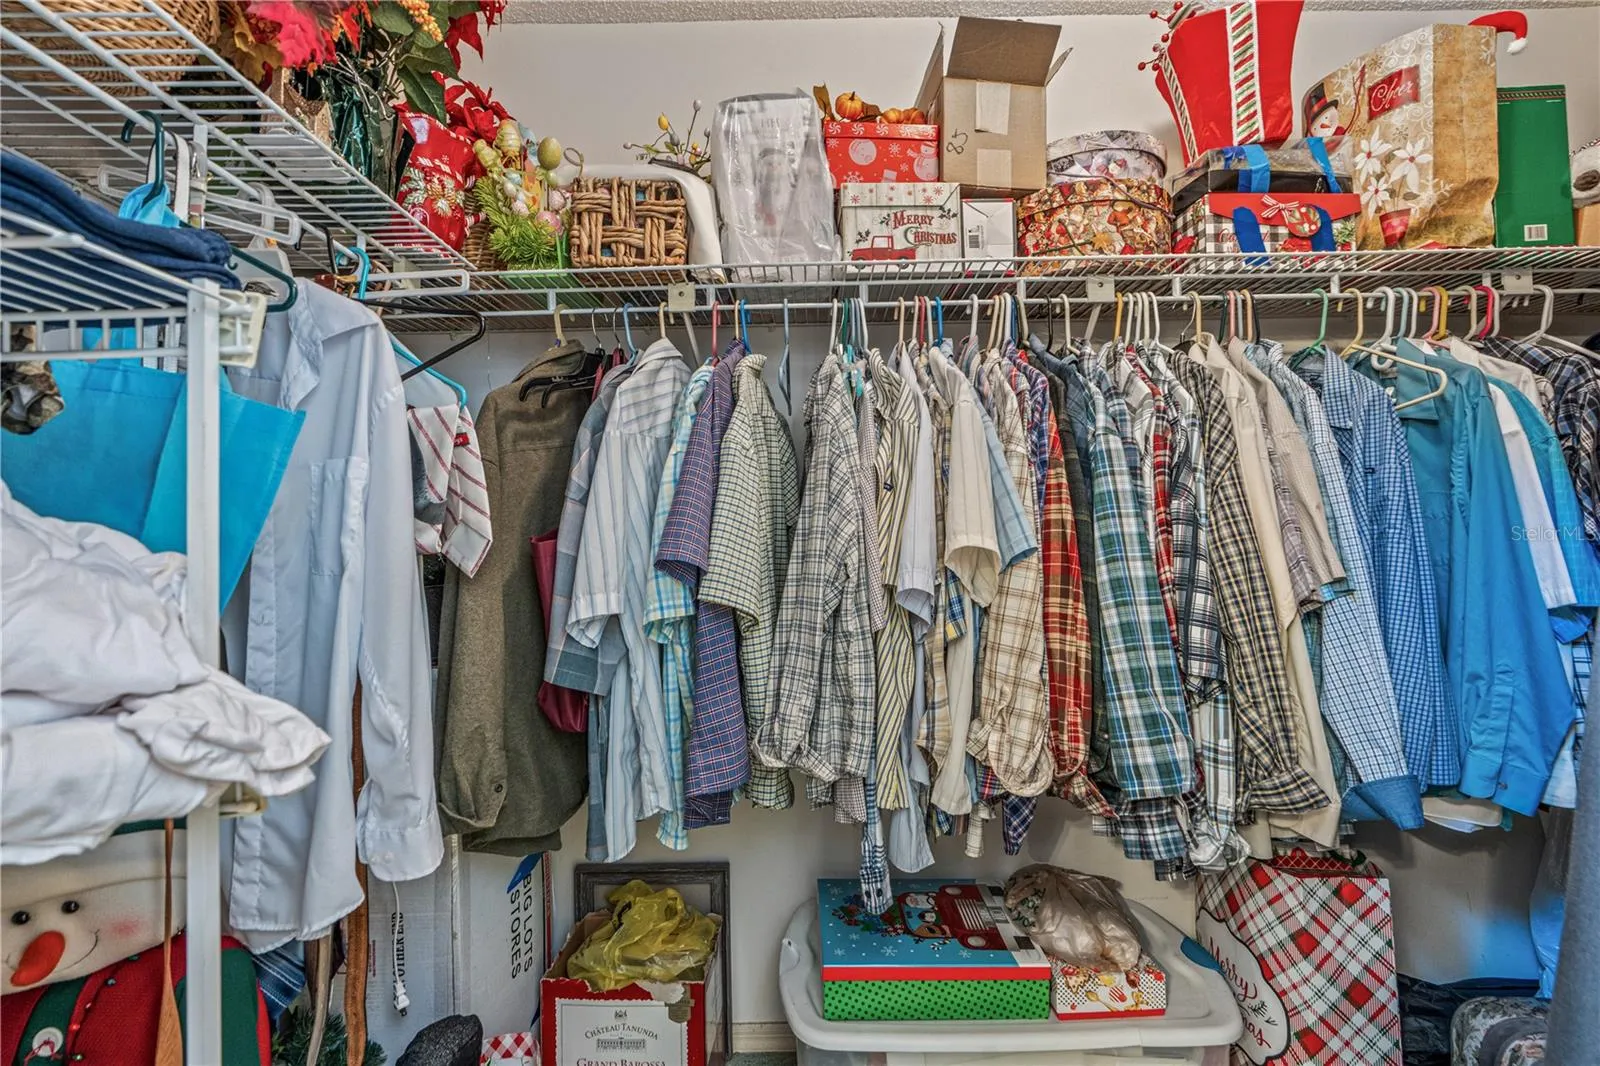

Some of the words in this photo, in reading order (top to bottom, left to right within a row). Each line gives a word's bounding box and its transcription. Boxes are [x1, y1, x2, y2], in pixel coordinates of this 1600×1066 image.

[1371, 78, 1414, 111] Cheer
[892, 210, 934, 229] MERRY
[904, 226, 957, 247] CHRISTMAS
[523, 873, 532, 912] BIG
[510, 889, 521, 979] STORES
[524, 914, 533, 972] LOTS
[622, 1022, 658, 1041] TANUNDA
